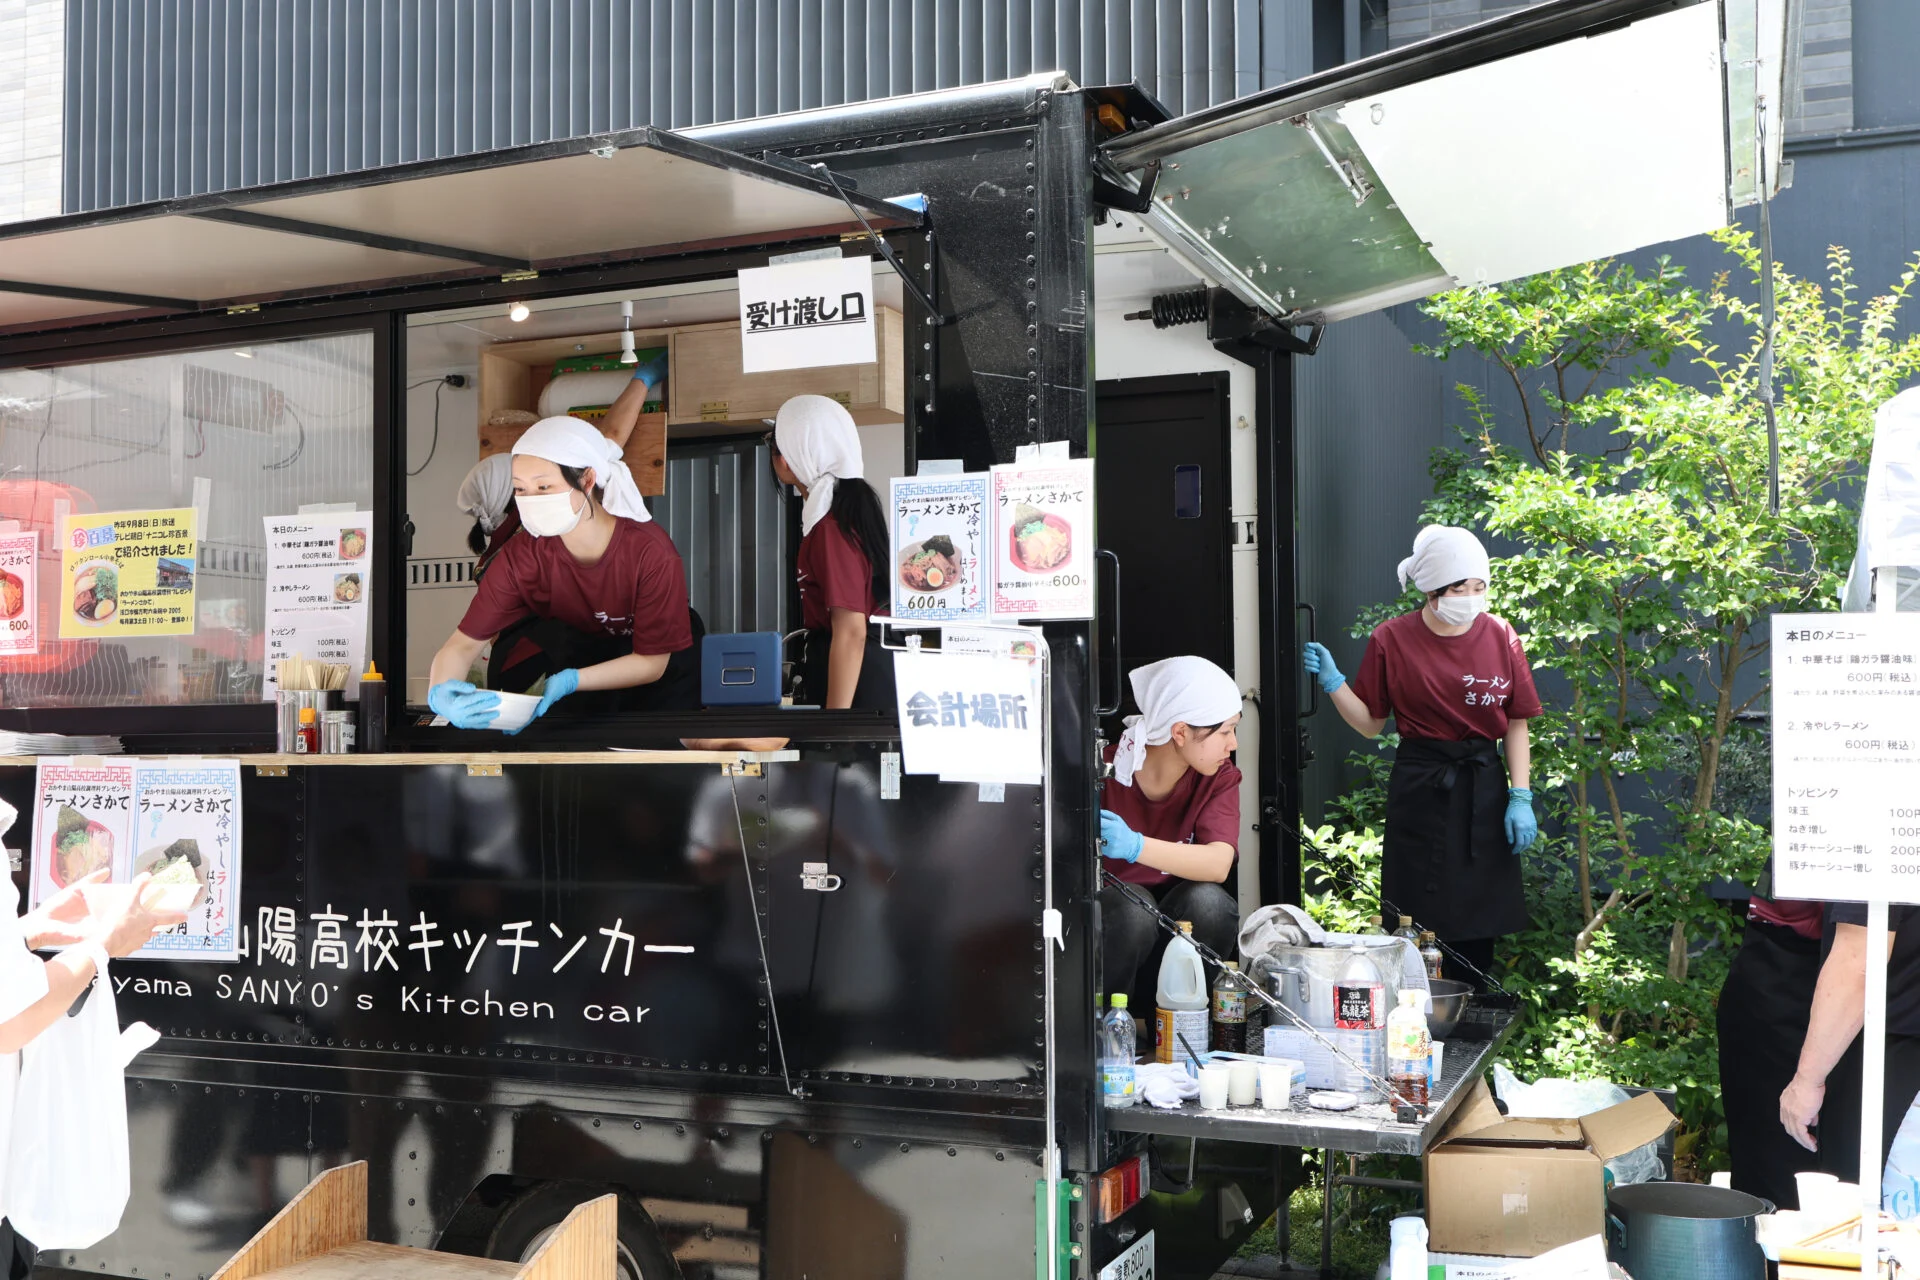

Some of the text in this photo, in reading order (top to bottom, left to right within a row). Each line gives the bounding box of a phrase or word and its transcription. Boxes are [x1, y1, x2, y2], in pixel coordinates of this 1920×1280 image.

[746, 292, 865, 330] 受け渡し口
[999, 490, 1084, 507] ラーメンさかて
[899, 502, 981, 518] ラーメンさかて
[273, 525, 313, 534] 本日のメニュー
[966, 514, 980, 609] 冷やしラーメン
[908, 595, 946, 610] 600円
[271, 628, 296, 636] トッピング
[1786, 630, 1867, 641] 本日のメニュー
[1462, 674, 1511, 690] ラーメン
[906, 690, 1028, 730] 会計場所
[1803, 721, 1869, 730] 冷やしラーメン
[48, 784, 127, 793] おかやま山陽高校調理科プレゼンツ
[144, 787, 228, 796] おかやま山陽高校調理科プレゼンツ
[44, 793, 130, 810] ラーメンさかて
[139, 797, 233, 814] ラーメンさかて
[1788, 806, 1810, 816] 味玉
[1789, 825, 1827, 834] ねぎ増し
[214, 813, 231, 936] 冷やしラーメン
[1789, 860, 1873, 873] 豚チャーシュー増し
[203, 870, 215, 947] はじめました
[402, 986, 554, 1020] Kitchen
[583, 1004, 650, 1023] car
[1340, 1003, 1370, 1018] 烏龍茶
[1131, 1246, 1144, 1275] 800
